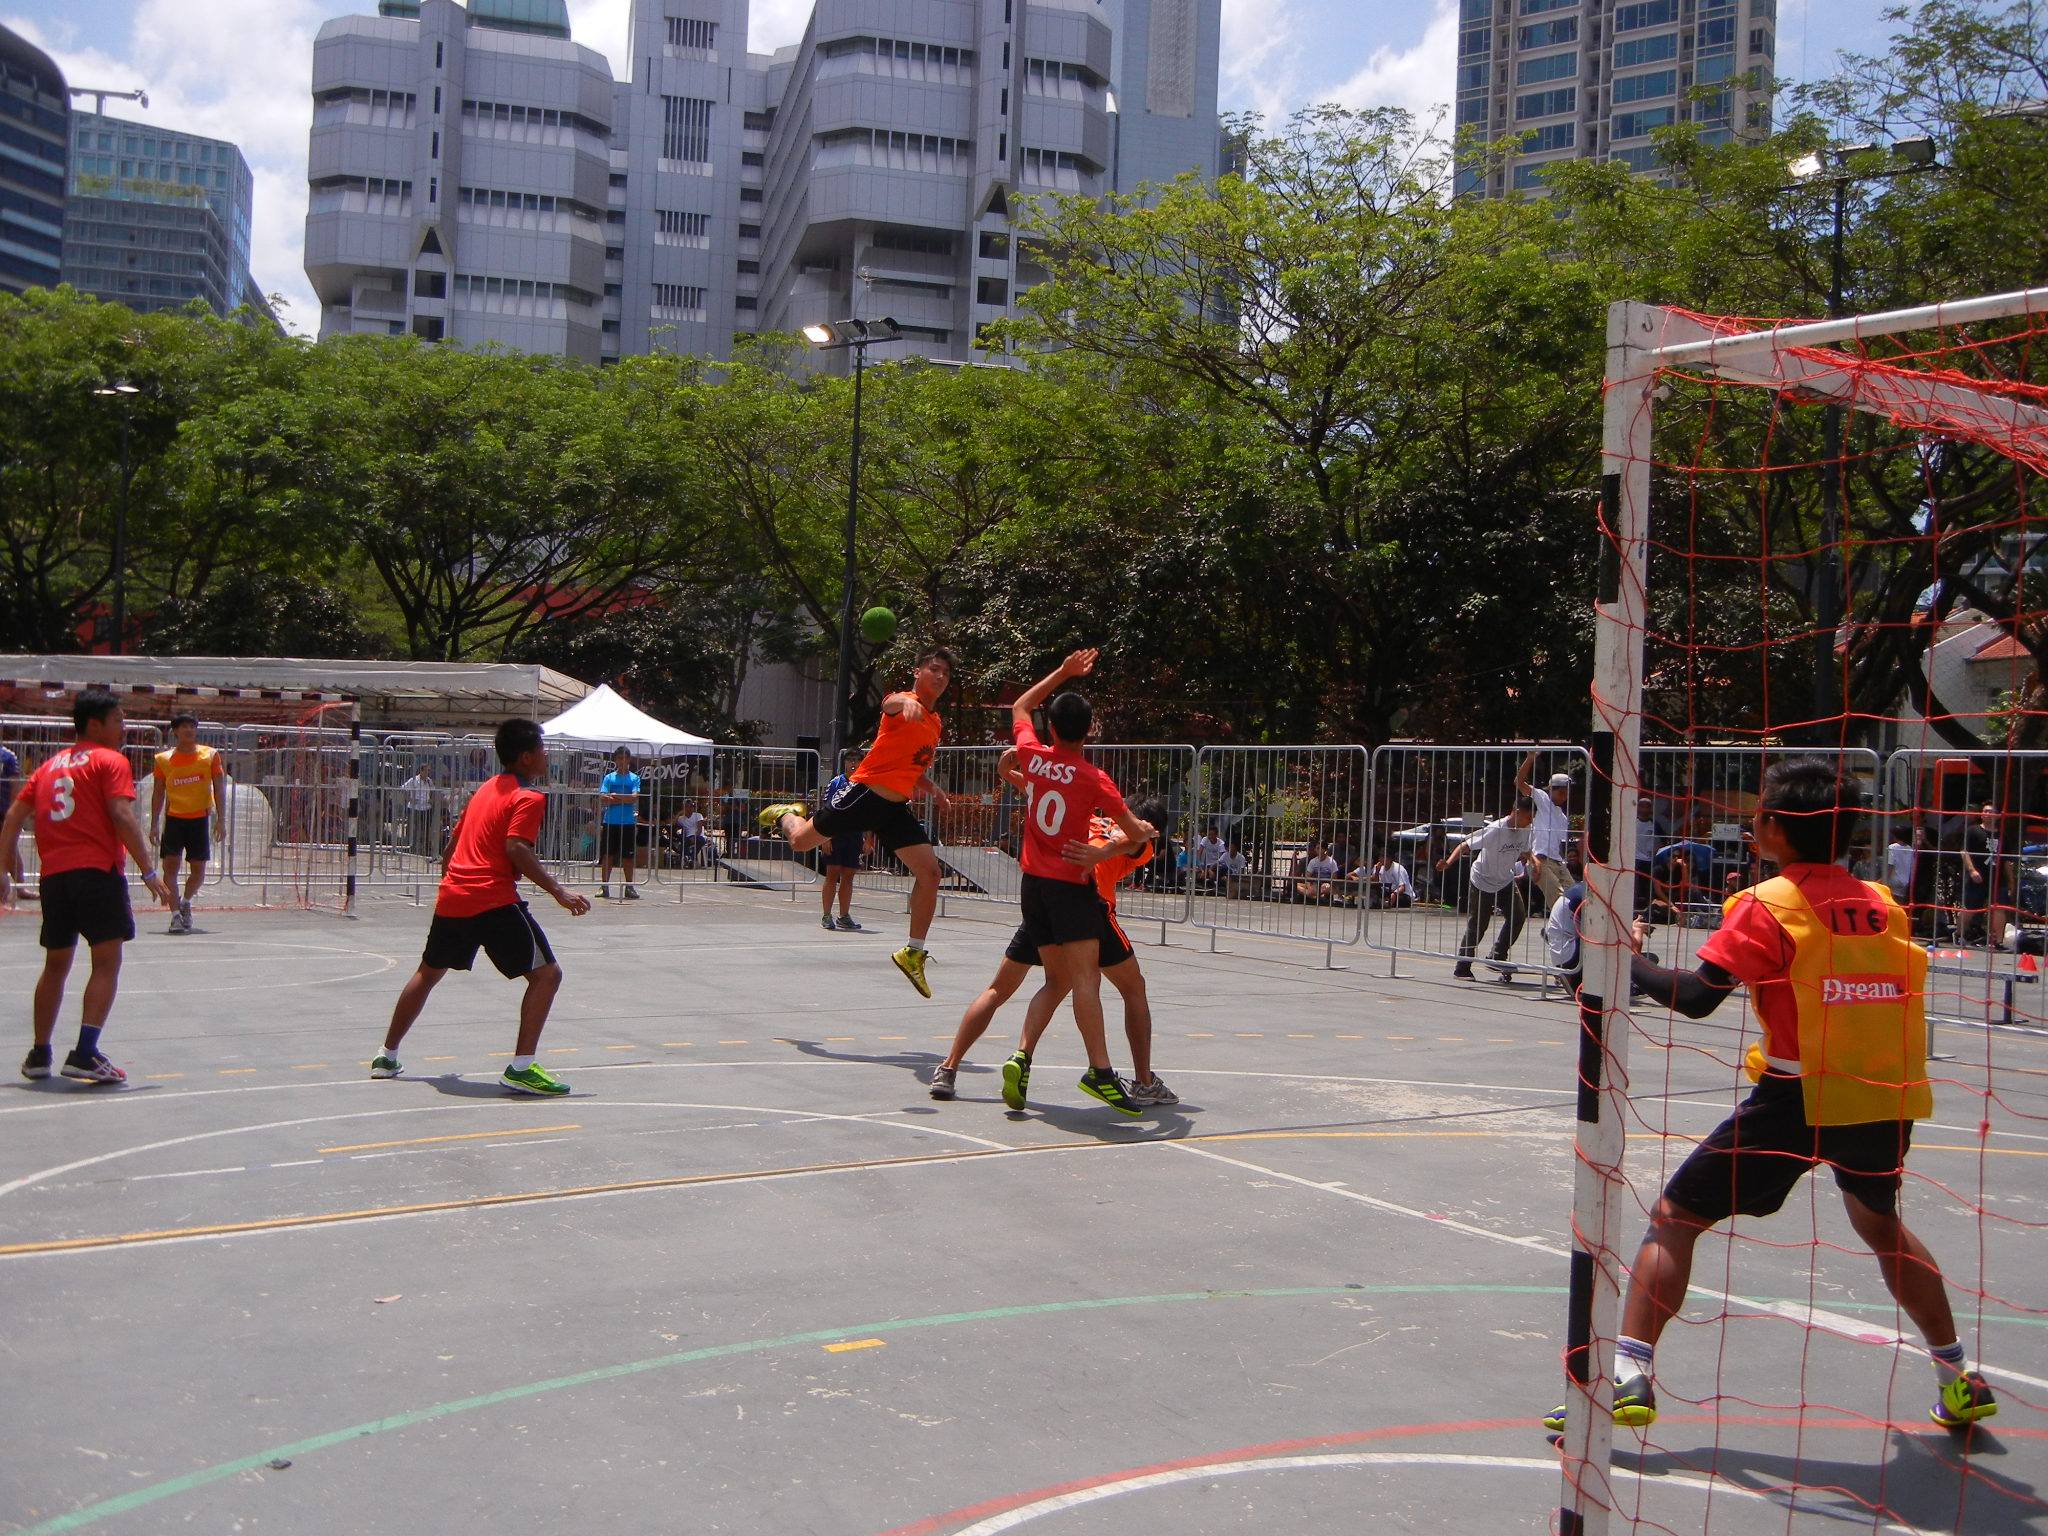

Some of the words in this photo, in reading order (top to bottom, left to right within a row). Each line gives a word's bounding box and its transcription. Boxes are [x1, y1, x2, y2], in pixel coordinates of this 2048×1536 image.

[51, 750, 93, 771] DASS
[1028, 754, 1077, 784] DASS
[173, 775, 201, 786] Dream
[50, 776, 76, 822] 3
[1025, 781, 1067, 837] 10
[1830, 907, 1882, 933] ITE
[1822, 978, 1898, 1003] Dream
